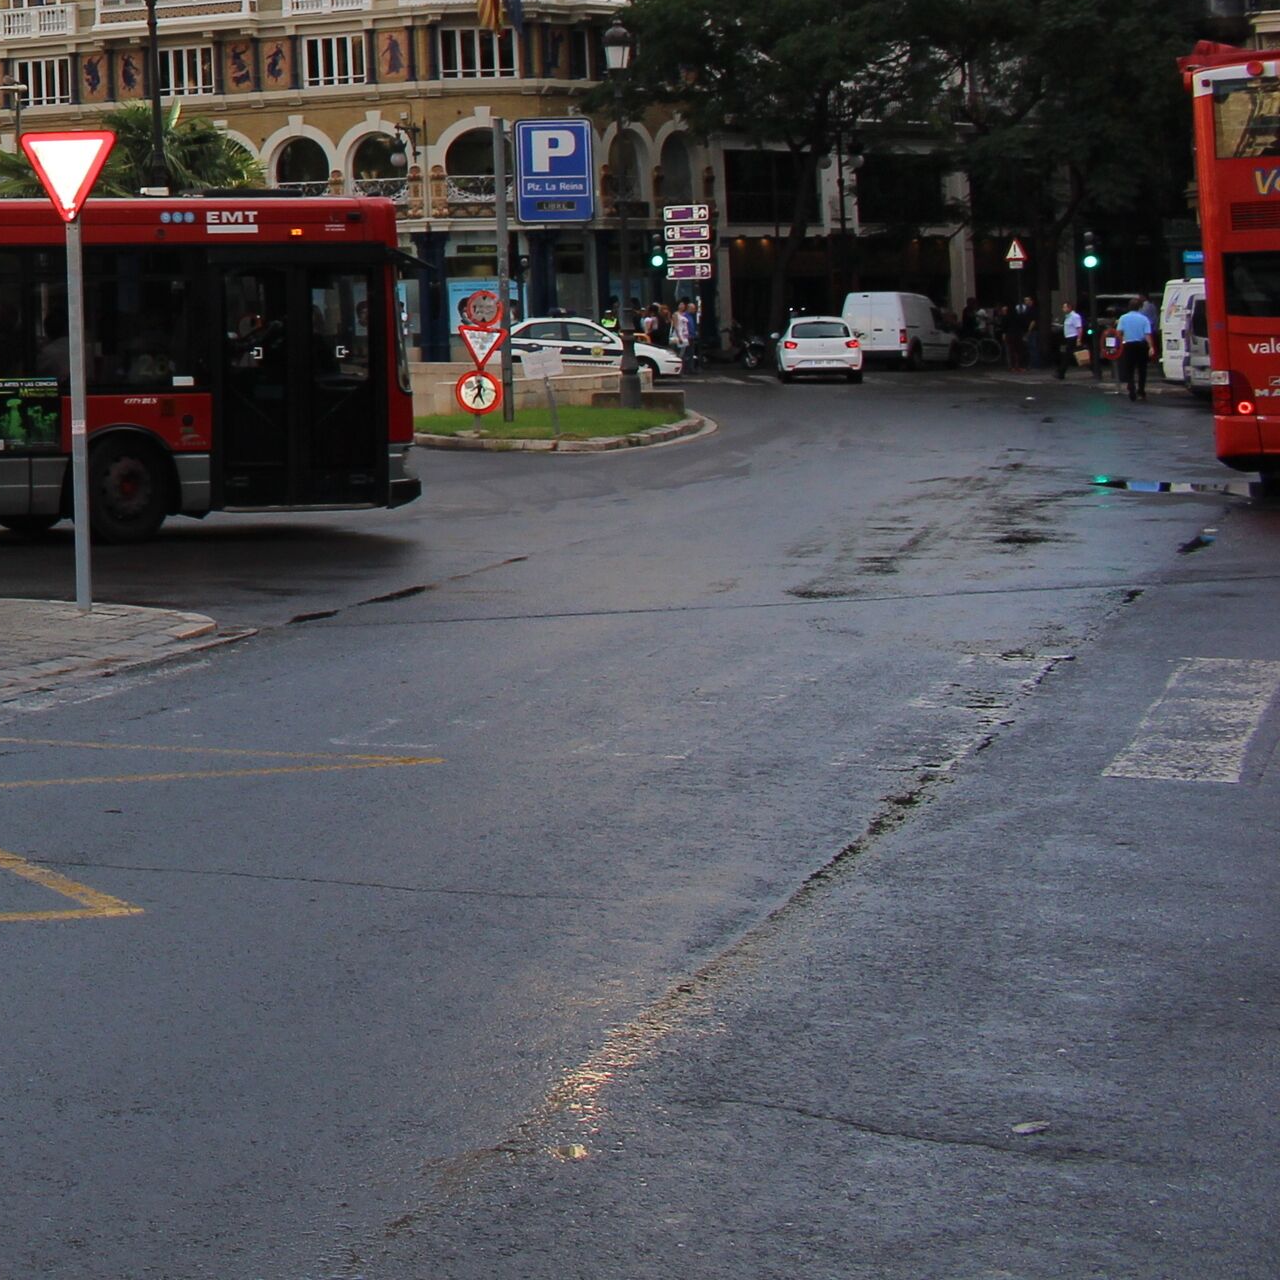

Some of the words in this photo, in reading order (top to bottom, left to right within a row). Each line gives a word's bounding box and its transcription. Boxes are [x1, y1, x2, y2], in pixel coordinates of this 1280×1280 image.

[531, 130, 576, 173] P
[527, 182, 542, 191] Plz.
[545, 182, 556, 191] La
[560, 182, 584, 191] Reina
[206, 211, 258, 223] EMT
